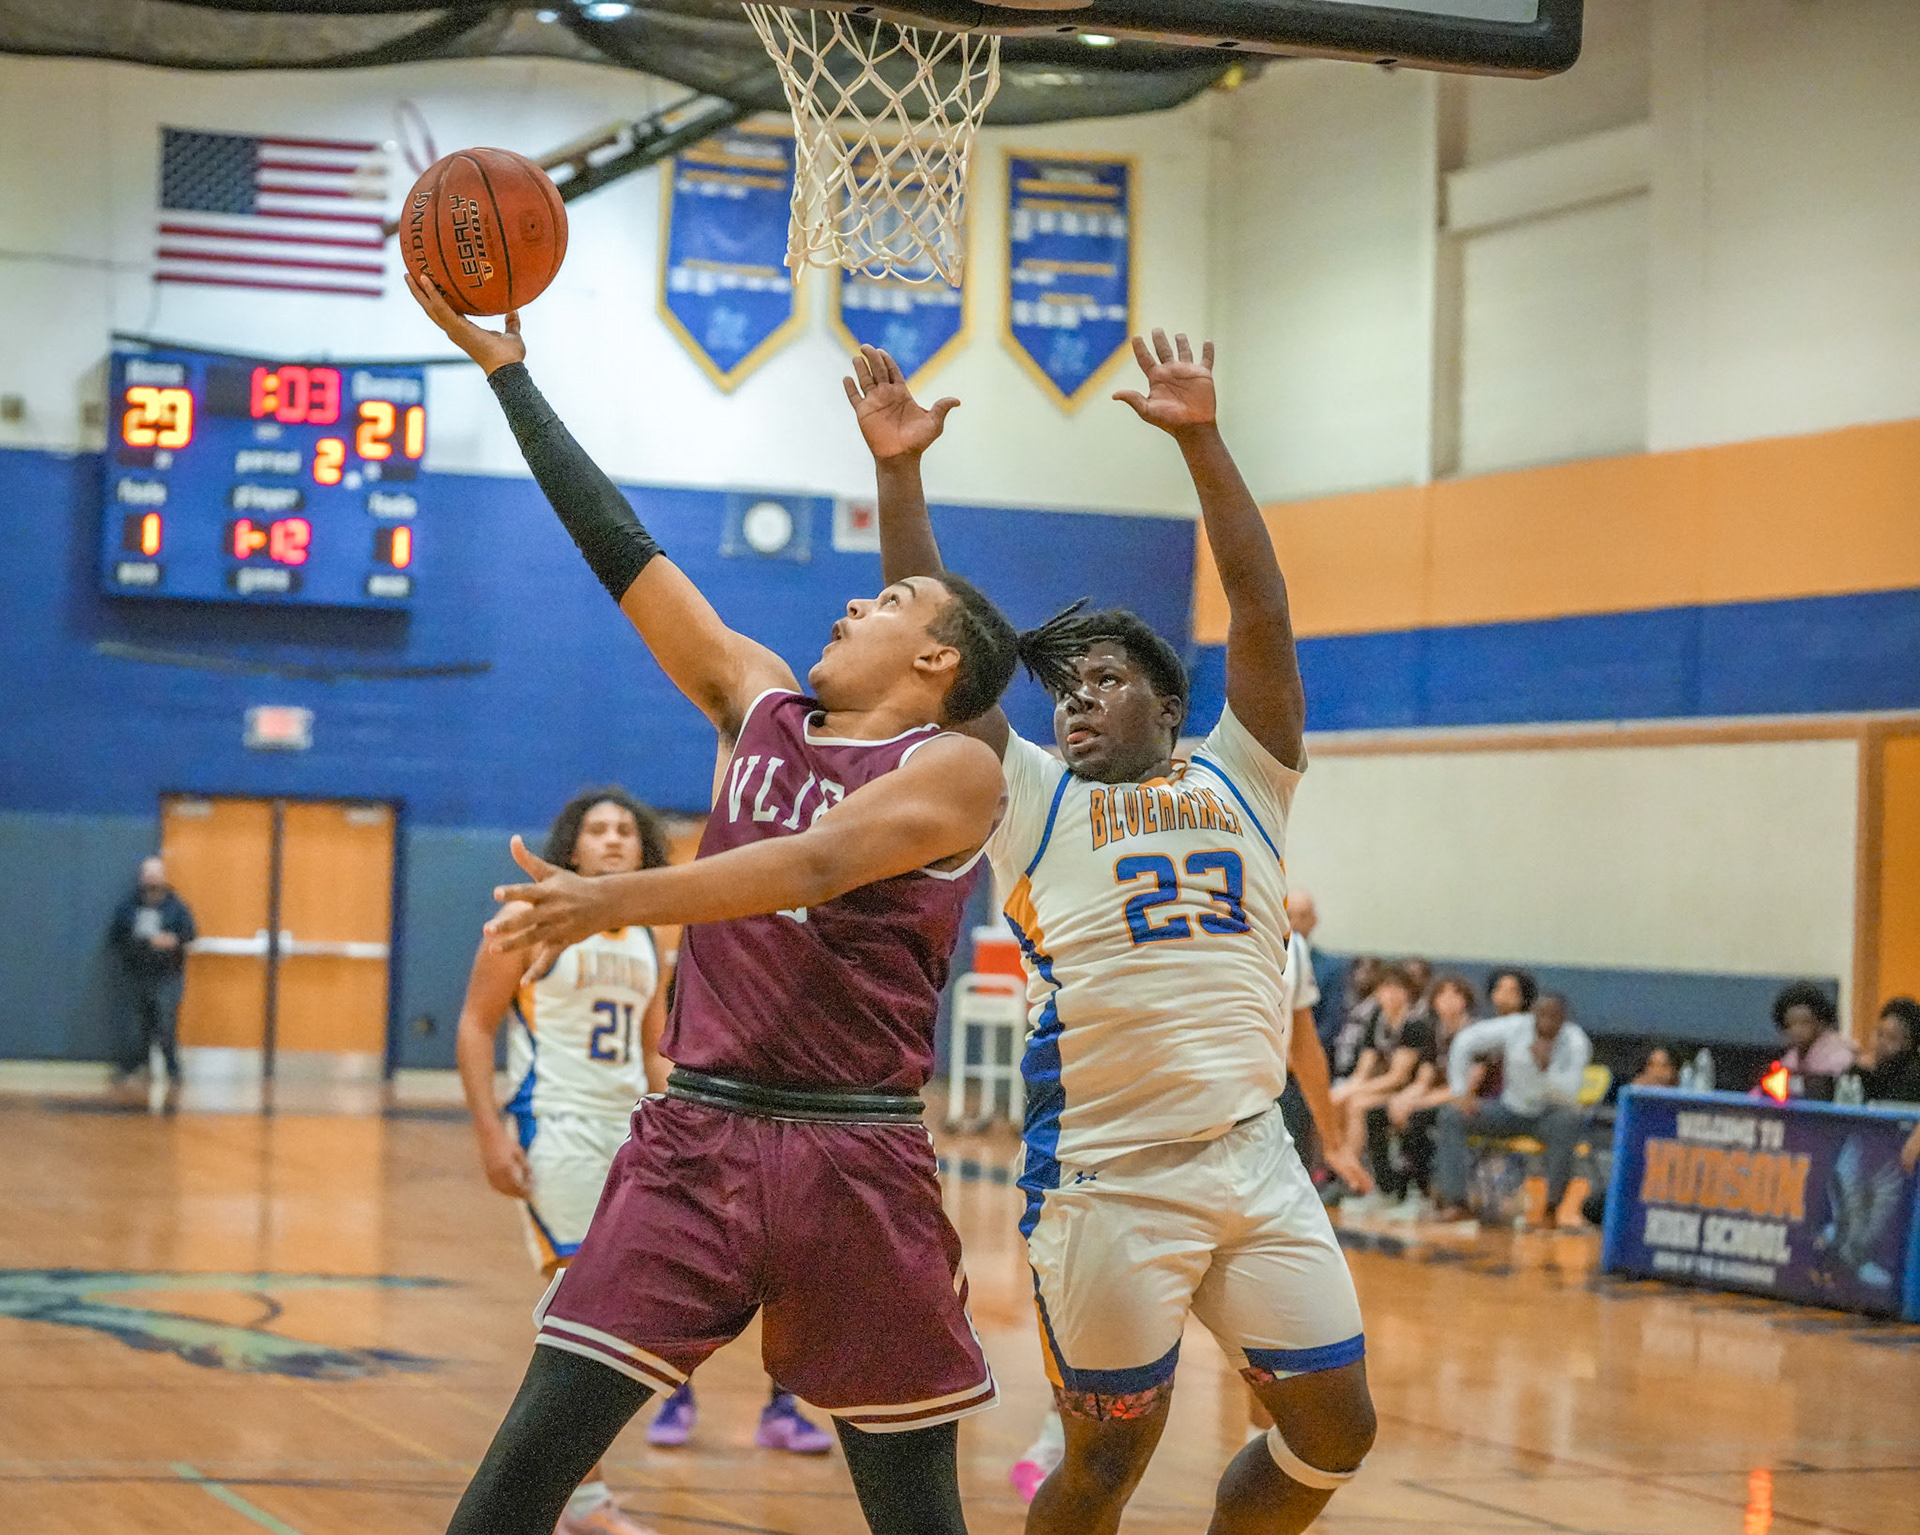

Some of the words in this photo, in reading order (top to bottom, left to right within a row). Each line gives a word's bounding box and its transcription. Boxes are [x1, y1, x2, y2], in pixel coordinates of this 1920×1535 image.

[449, 195, 485, 289] LEGACY
[469, 199, 488, 258] 1000
[123, 386, 194, 448] 29
[251, 365, 341, 424] 1:03
[356, 401, 425, 460] 21
[313, 437, 347, 485] 2
[141, 512, 161, 556] 1
[391, 526, 412, 569] 1
[1113, 848, 1253, 948] 23
[589, 999, 634, 1062] 21
[1641, 1137, 1811, 1222] HUDSON
